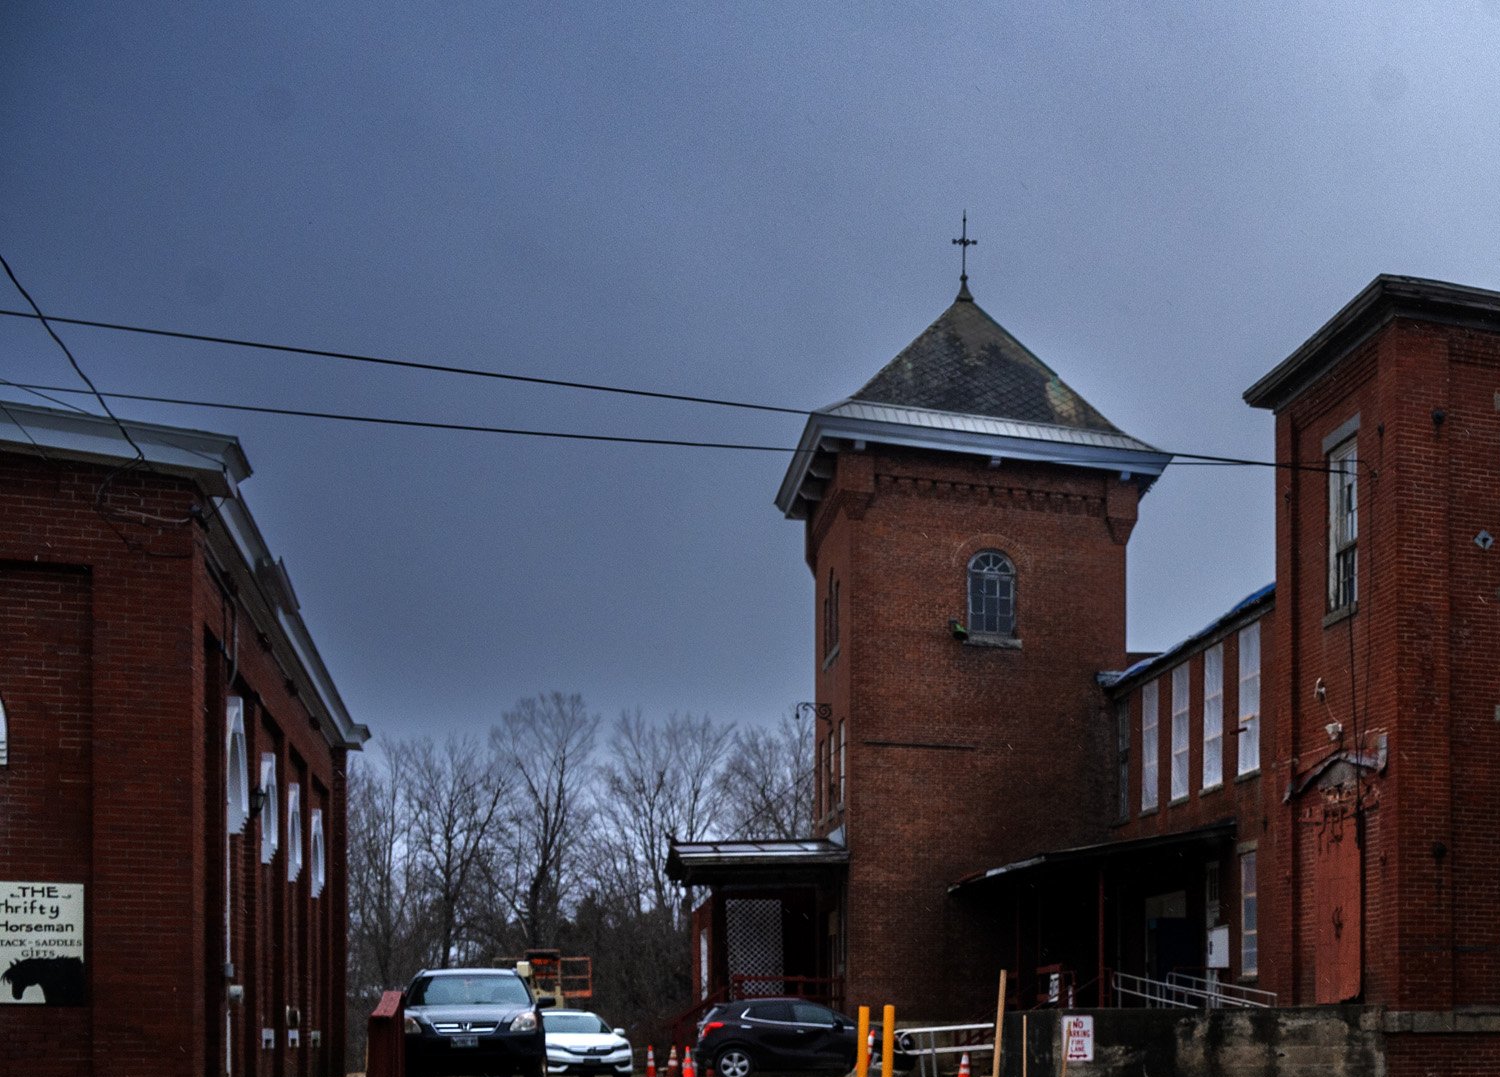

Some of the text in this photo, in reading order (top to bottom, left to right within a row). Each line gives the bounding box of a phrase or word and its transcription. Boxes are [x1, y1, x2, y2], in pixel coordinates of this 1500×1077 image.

[17, 886, 59, 899] THE
[0, 920, 74, 932] Horseman
[35, 939, 83, 947] SADDLES
